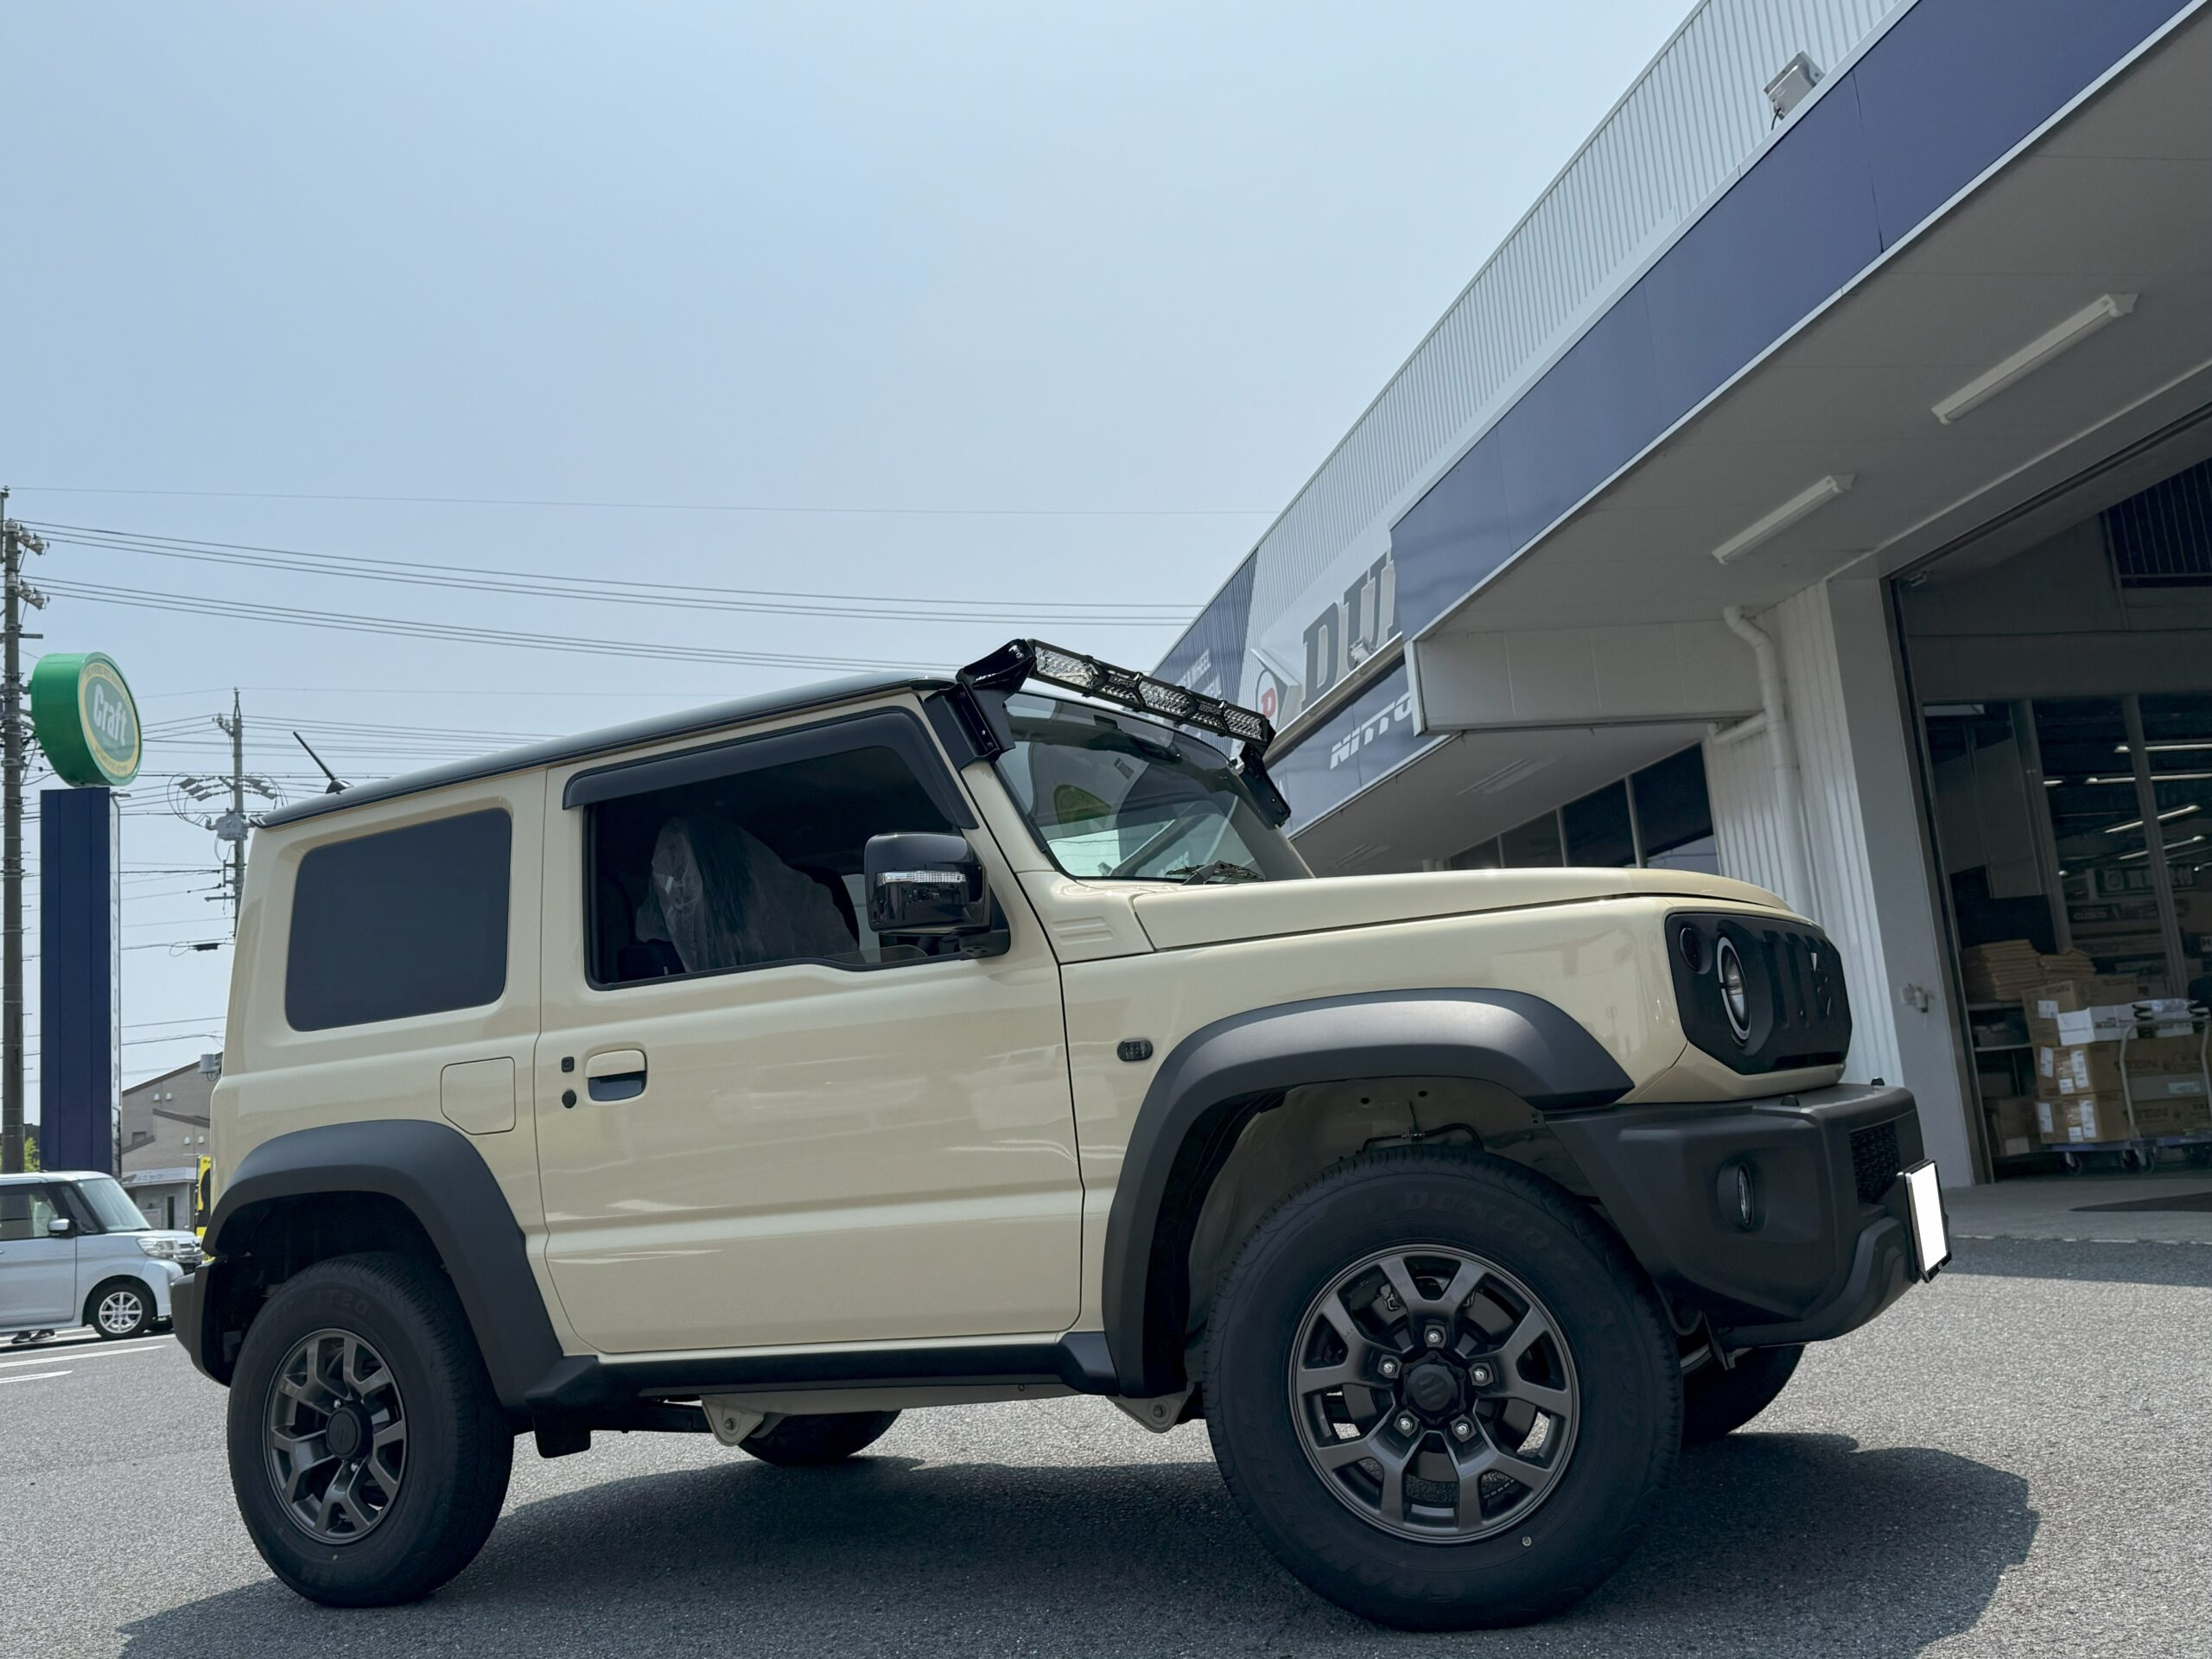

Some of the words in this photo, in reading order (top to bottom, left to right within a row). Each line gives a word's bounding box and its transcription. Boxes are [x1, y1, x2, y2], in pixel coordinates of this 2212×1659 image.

[1300, 550, 1402, 712] DU
[92, 683, 127, 747] Craft
[1330, 691, 1412, 770] NITTO
